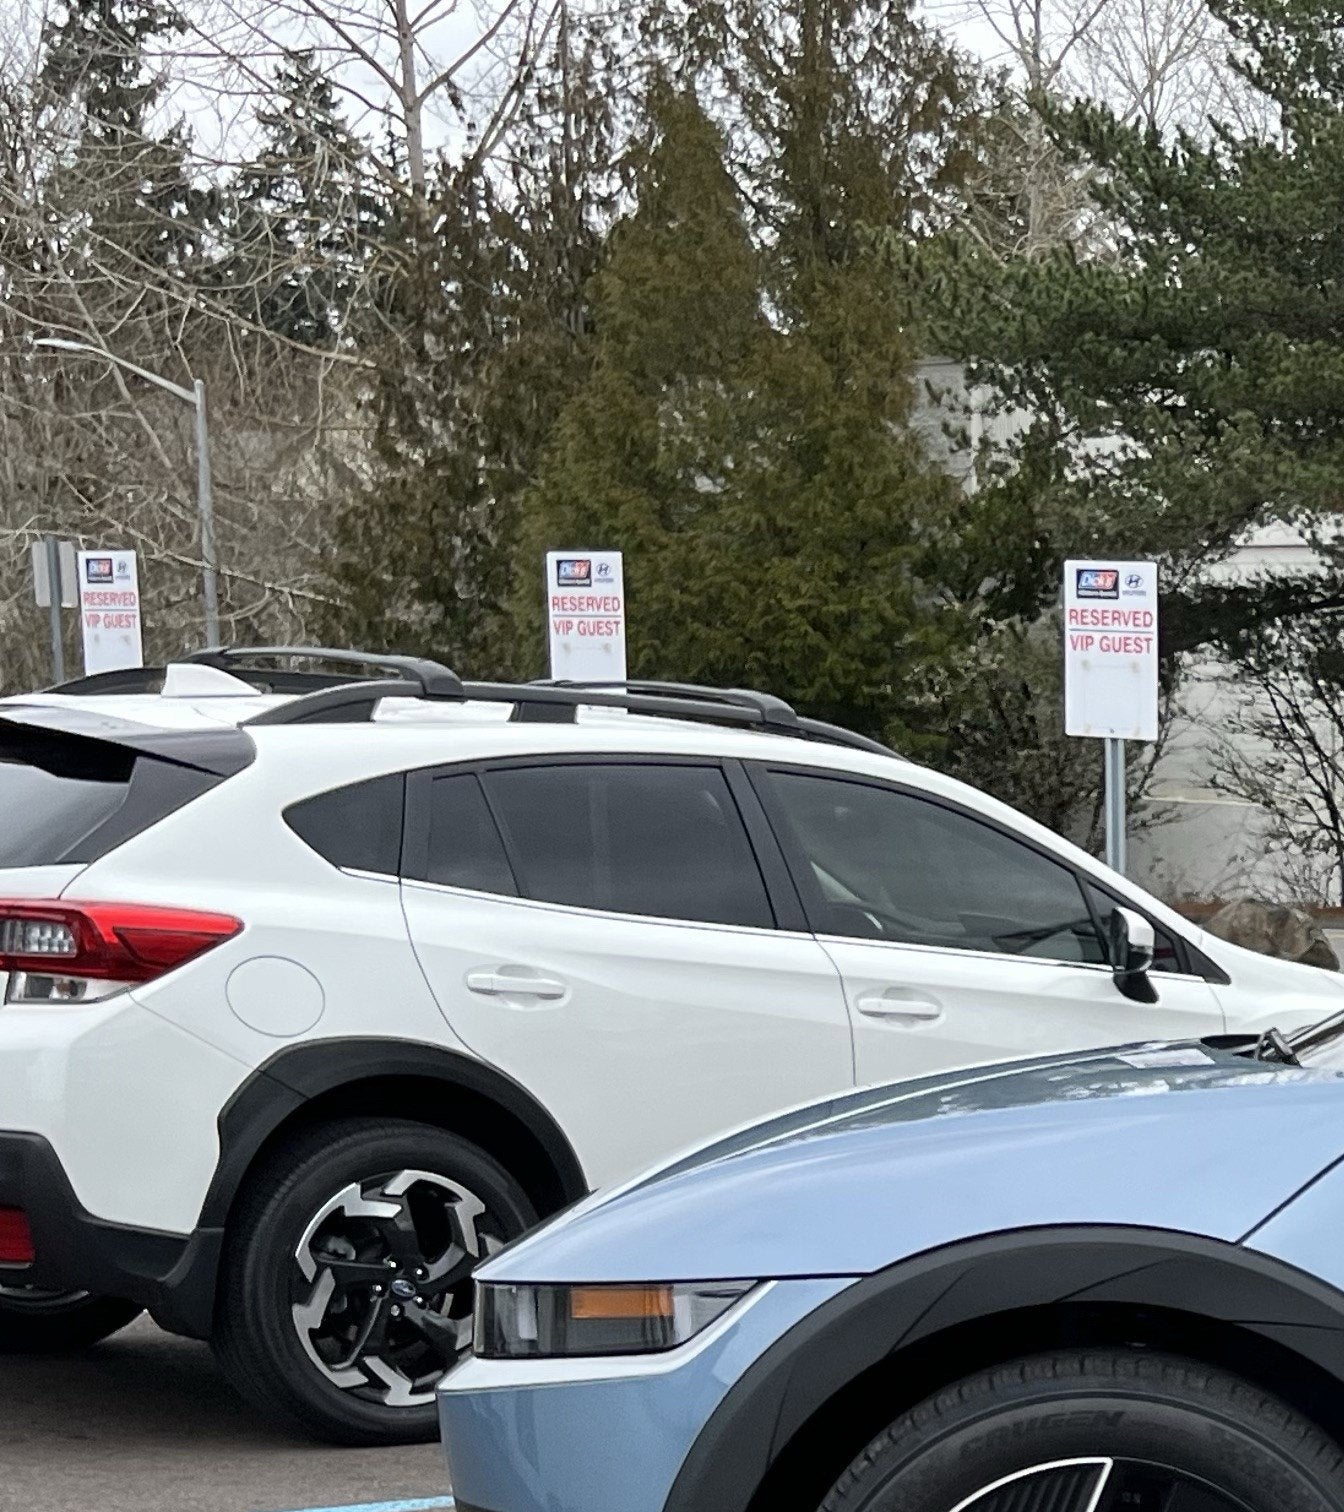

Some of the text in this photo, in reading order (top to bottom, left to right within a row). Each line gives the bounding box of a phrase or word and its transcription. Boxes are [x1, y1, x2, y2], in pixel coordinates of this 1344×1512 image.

[83, 591, 137, 607] RESERVED
[552, 596, 621, 612] RESERVED
[103, 613, 137, 629] GUEST
[1068, 608, 1154, 628] RESERVED
[553, 620, 621, 637] VIP GUEST
[1070, 635, 1154, 654] VIP GUEST
